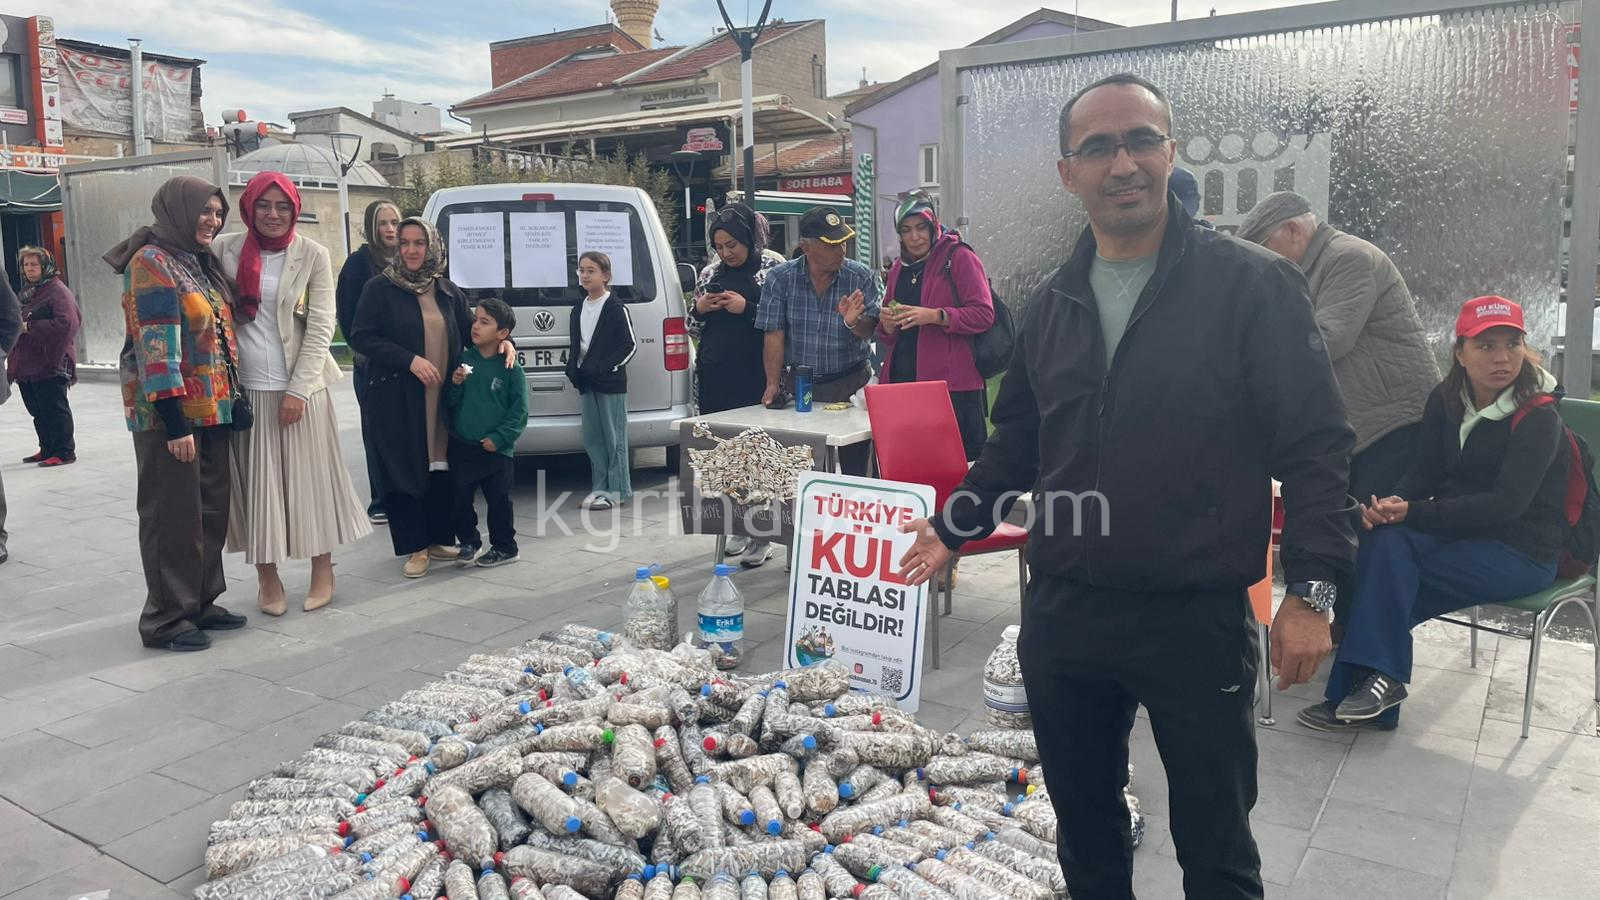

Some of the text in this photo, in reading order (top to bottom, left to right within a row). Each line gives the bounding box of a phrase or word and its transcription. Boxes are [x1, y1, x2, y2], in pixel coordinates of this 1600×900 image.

[812, 176, 843, 188] BABA
[535, 350, 552, 366] FR
[813, 492, 913, 526] TÜRKİYE
[811, 524, 909, 585] KÜL
[808, 573, 906, 611] TABLASI
[805, 601, 904, 637] DEĞİLDİR!
